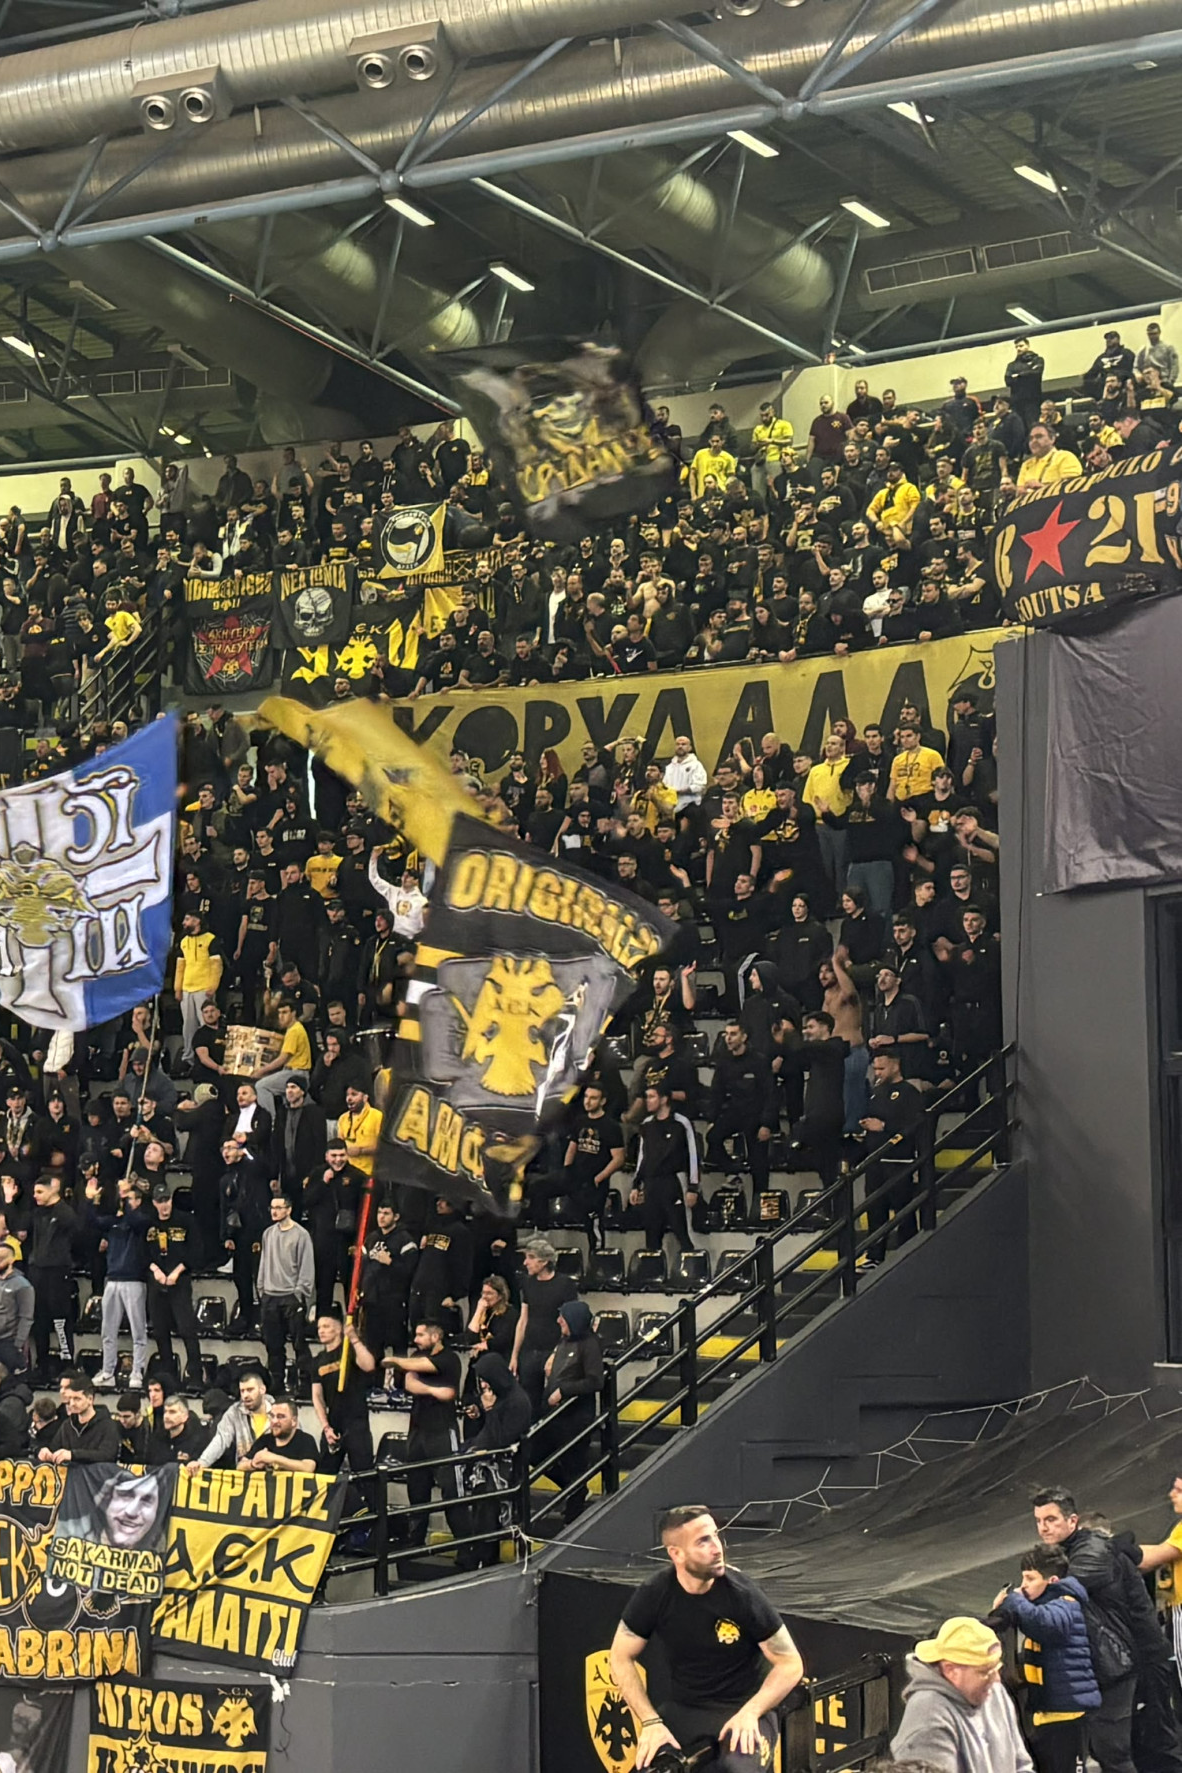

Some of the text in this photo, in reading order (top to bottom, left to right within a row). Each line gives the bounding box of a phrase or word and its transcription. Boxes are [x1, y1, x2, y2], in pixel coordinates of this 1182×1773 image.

[52, 1560, 161, 1595] NOT DEAD
[96, 1681, 203, 1736] NEOS
